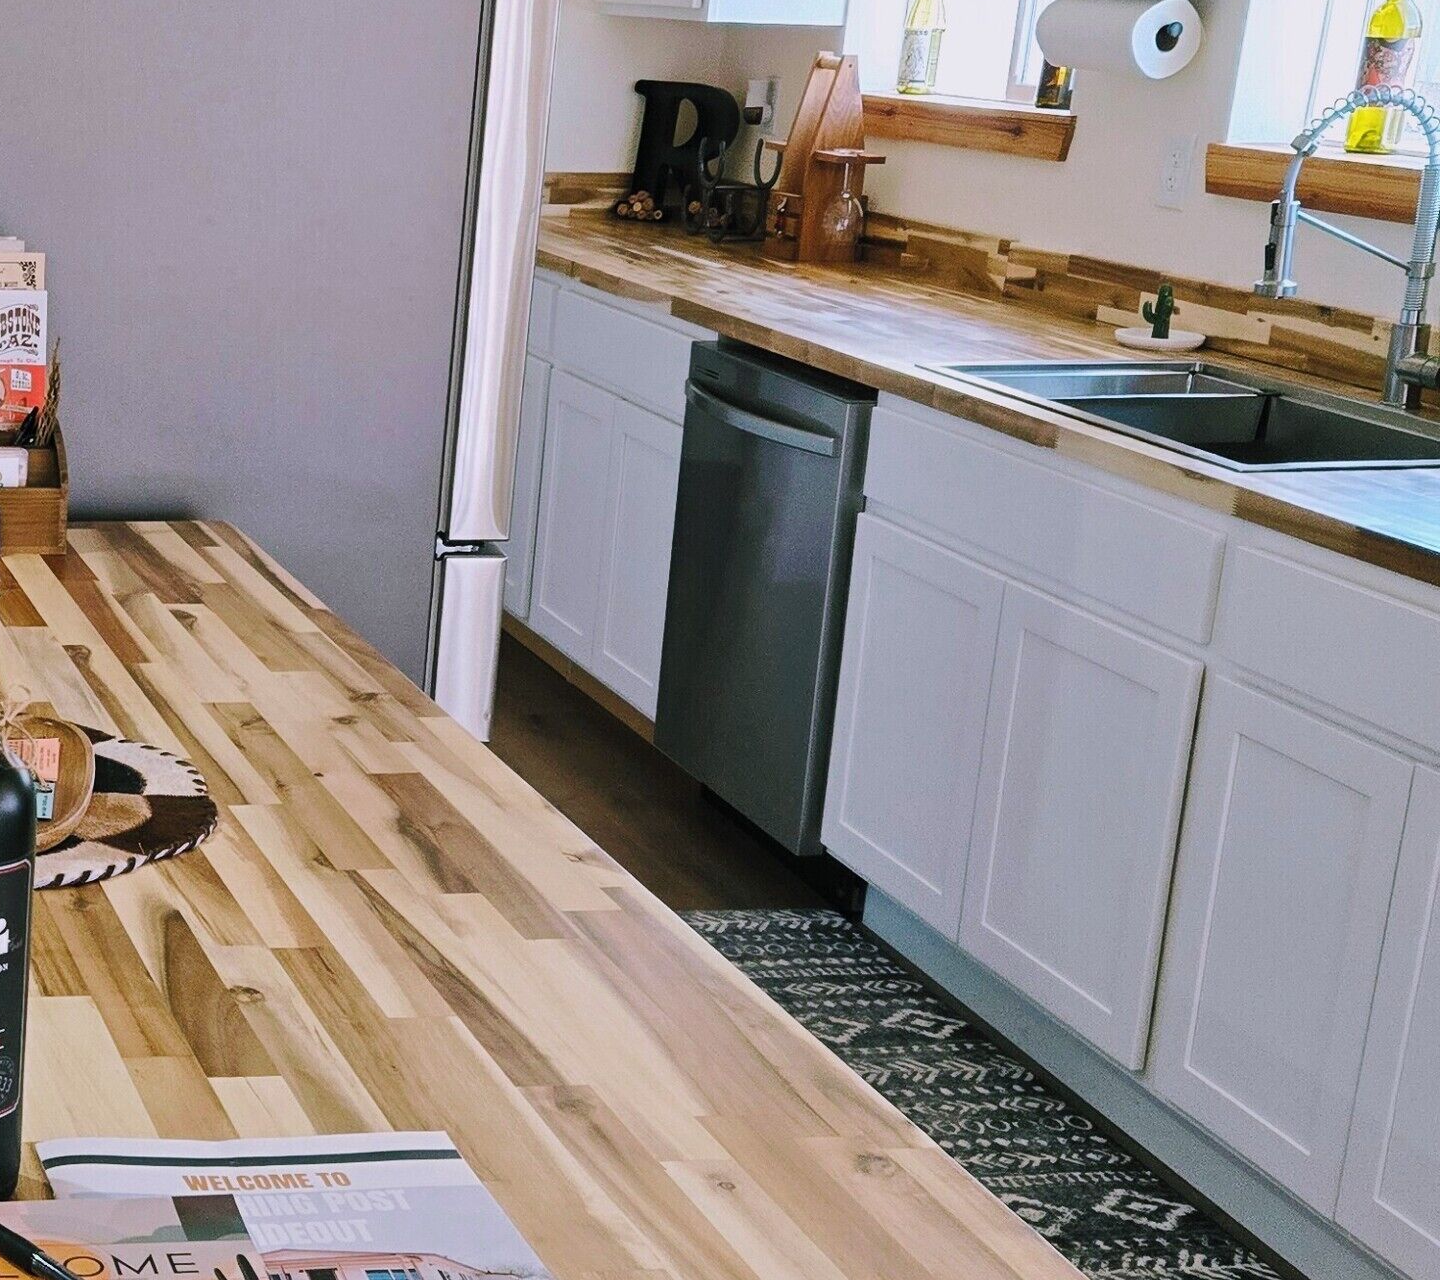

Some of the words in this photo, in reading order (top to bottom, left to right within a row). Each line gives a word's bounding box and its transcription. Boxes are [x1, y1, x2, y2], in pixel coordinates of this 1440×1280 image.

[182, 1172, 314, 1191] WELCOME
[316, 1171, 352, 1187] TO
[241, 1193, 319, 1217] HING
[321, 1188, 411, 1214] POST
[255, 1218, 373, 1246] IDEOUT
